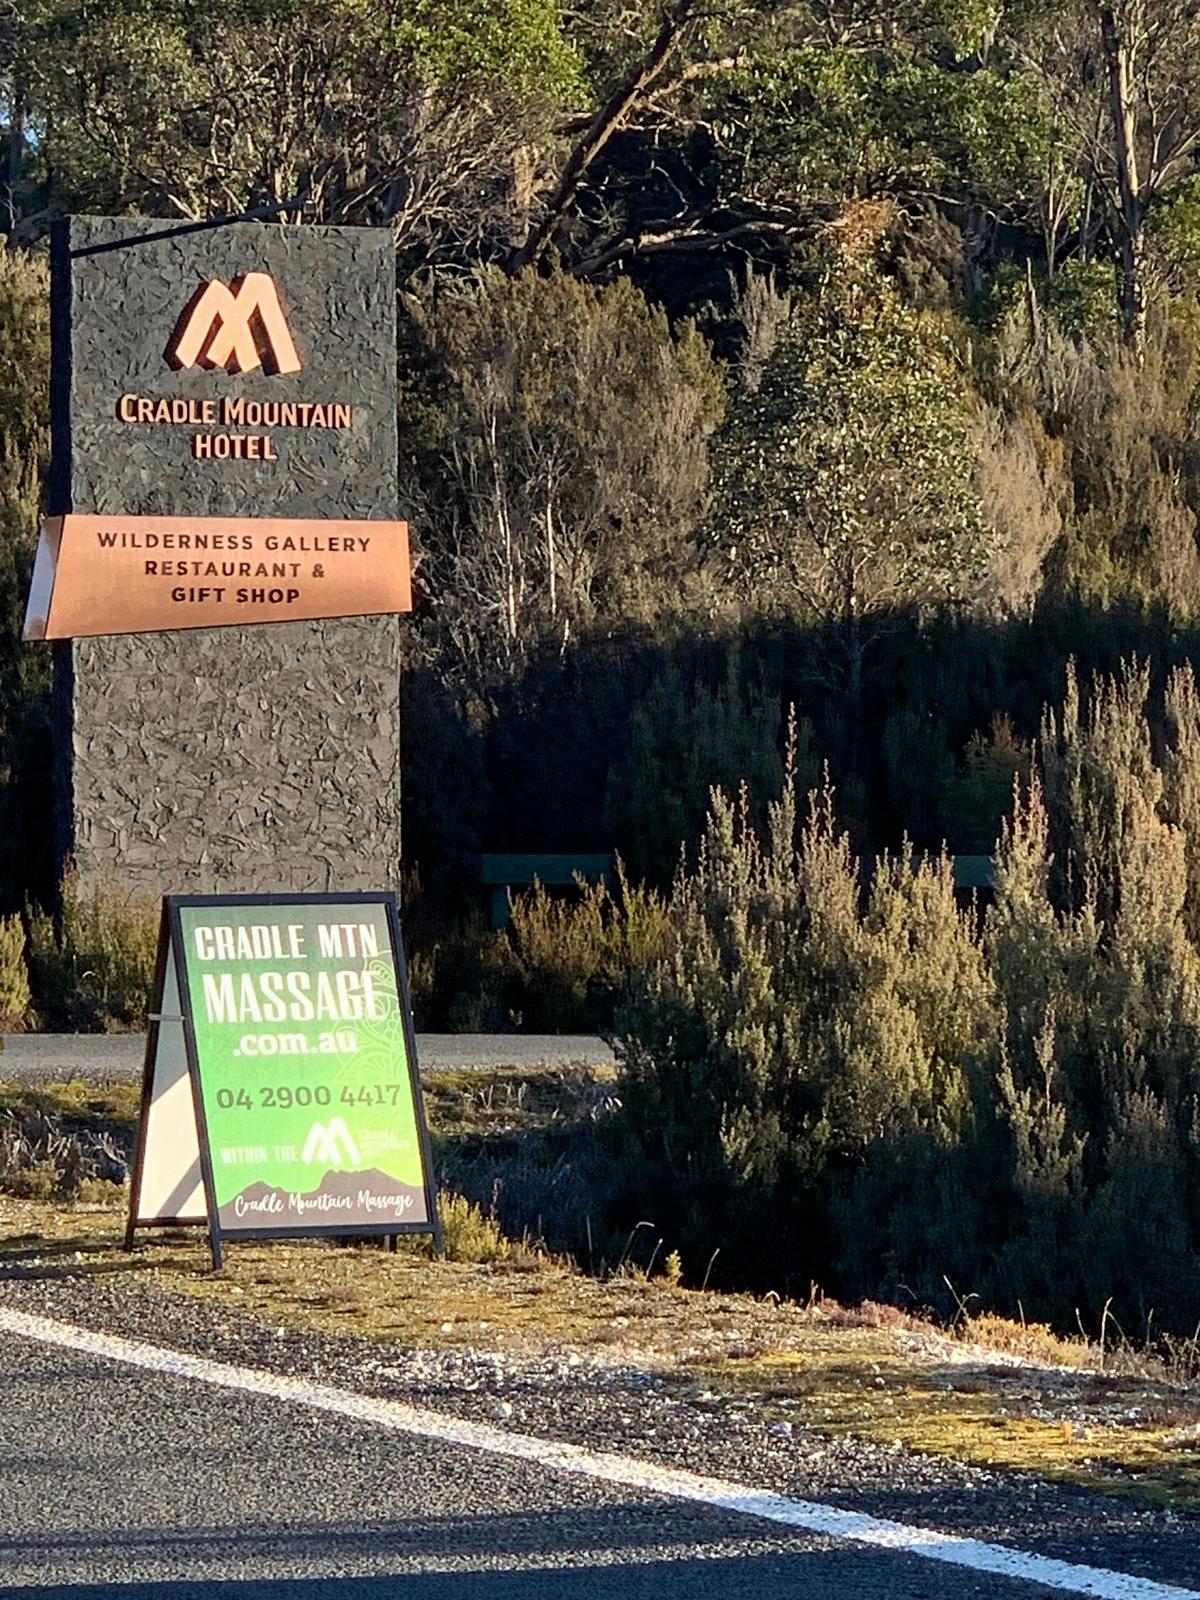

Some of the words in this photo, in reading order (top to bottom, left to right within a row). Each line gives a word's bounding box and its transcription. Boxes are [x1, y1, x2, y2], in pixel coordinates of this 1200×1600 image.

[119, 393, 216, 425] CRADLE
[223, 397, 352, 429] MOUNTAIN
[194, 434, 277, 461] HOTEL
[98, 532, 253, 550] WILDERNESS
[264, 536, 371, 552] GALLERY
[145, 560, 301, 578] RESTAURANT
[312, 563, 325, 578] &
[171, 587, 226, 604] GIFT
[236, 588, 300, 604] SHOP
[194, 924, 308, 961] CRADLE
[318, 923, 379, 958] MTN
[202, 970, 387, 1025] MASSAGE
[232, 1029, 360, 1058] .com.au
[216, 1088, 253, 1110] 04
[259, 1085, 331, 1108] 2900
[339, 1083, 401, 1107] 4417
[234, 1193, 285, 1217] Cradle
[288, 1192, 354, 1215] Mountain
[356, 1189, 414, 1216] Massage
